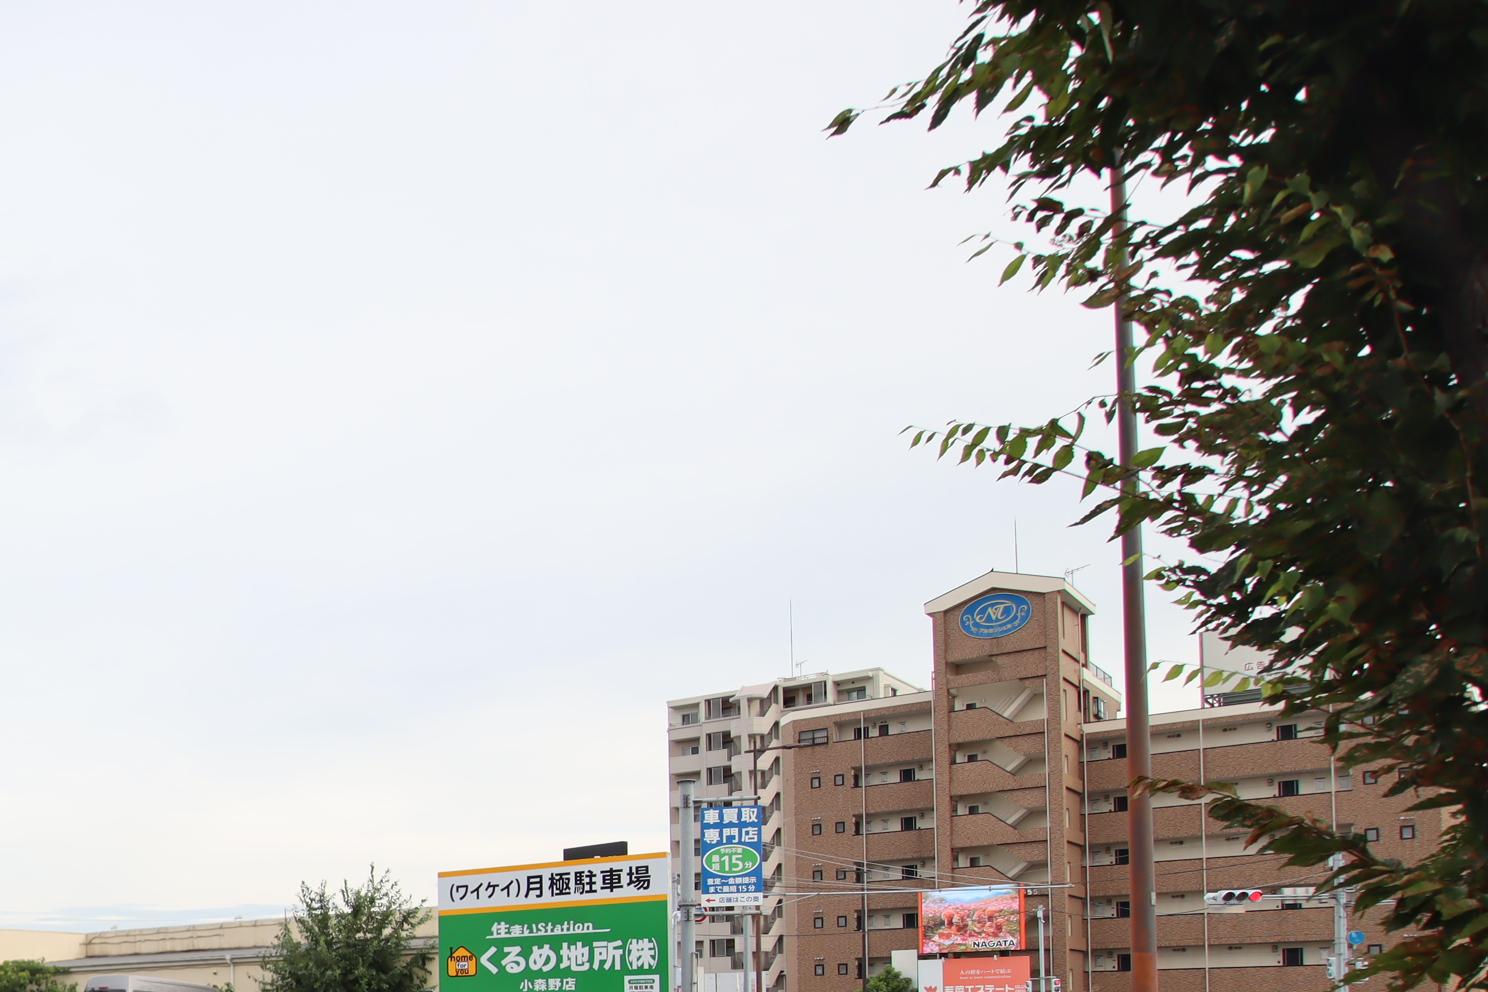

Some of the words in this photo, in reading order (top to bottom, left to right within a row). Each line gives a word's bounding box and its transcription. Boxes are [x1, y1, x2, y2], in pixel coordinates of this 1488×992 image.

[703, 807, 758, 825] 車買取
[703, 827, 759, 844] 専門店
[972, 939, 1015, 949] NAGATA
[457, 961, 467, 969] for
[455, 968, 470, 976] you
[519, 977, 576, 992] 小森野店
